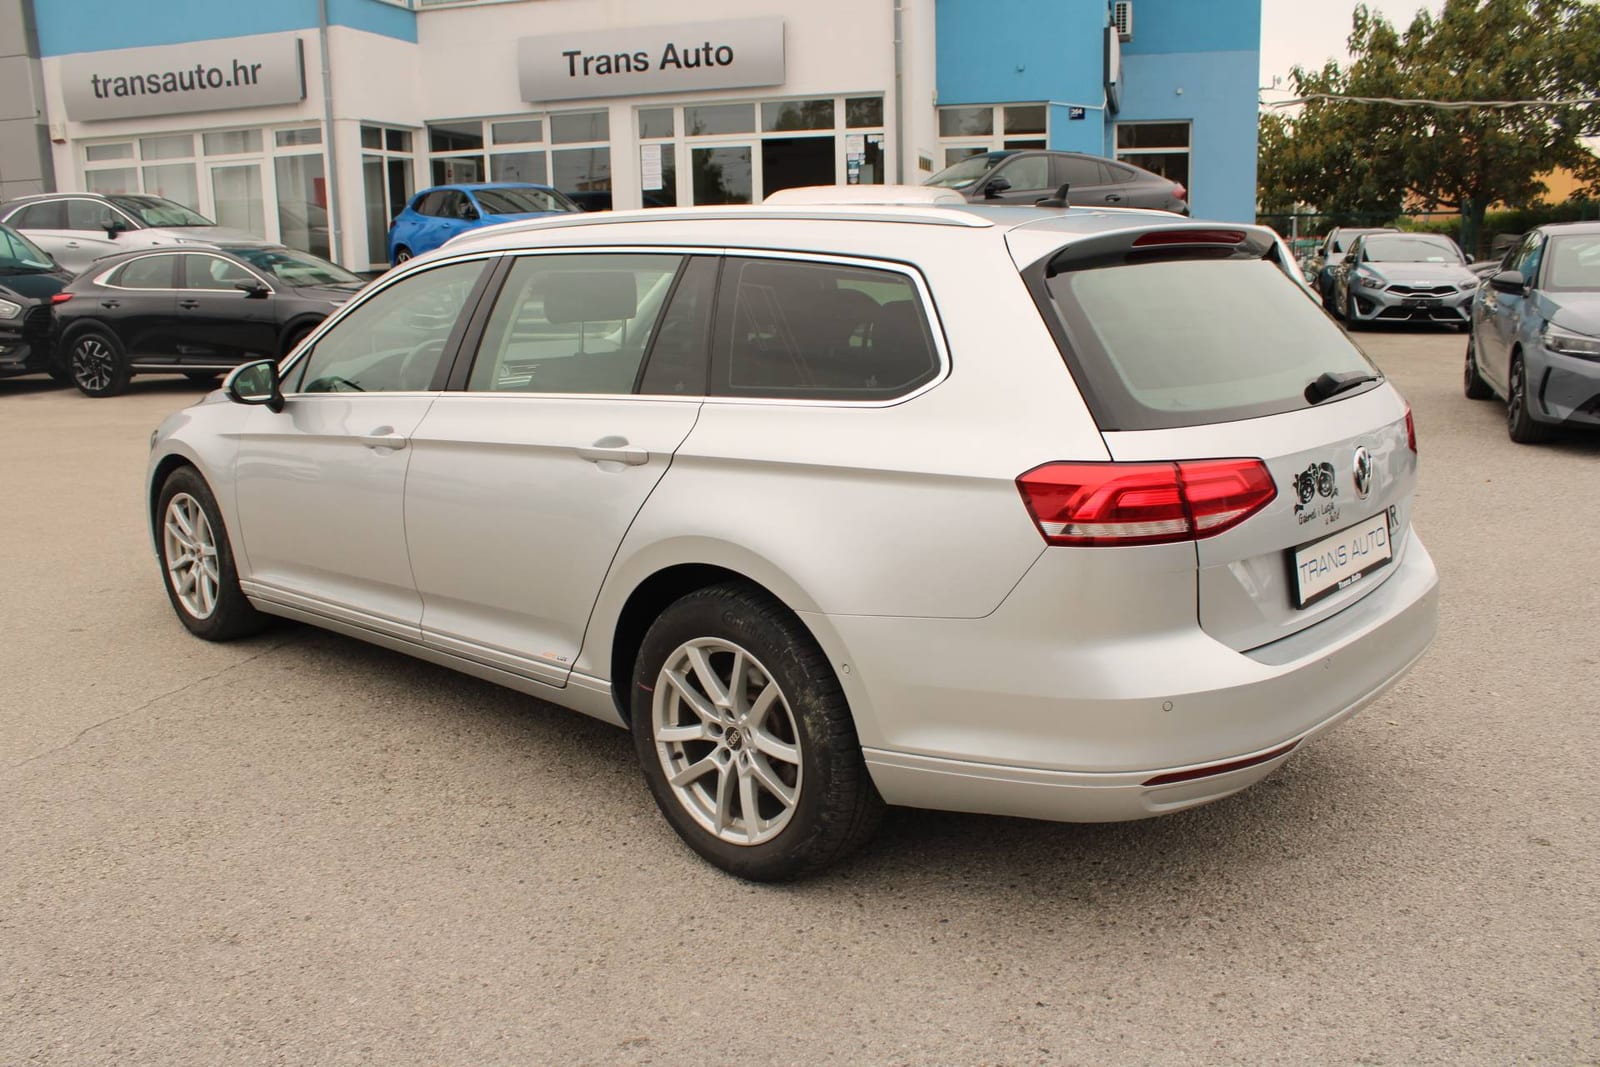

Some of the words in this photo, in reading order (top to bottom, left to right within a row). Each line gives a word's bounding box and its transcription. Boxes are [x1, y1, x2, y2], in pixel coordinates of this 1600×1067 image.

[91, 58, 262, 99] transauto.hr
[562, 50, 649, 77] Trans
[659, 41, 734, 70] Auto
[1300, 545, 1348, 584] TRANS
[1352, 526, 1386, 560] AUTO
